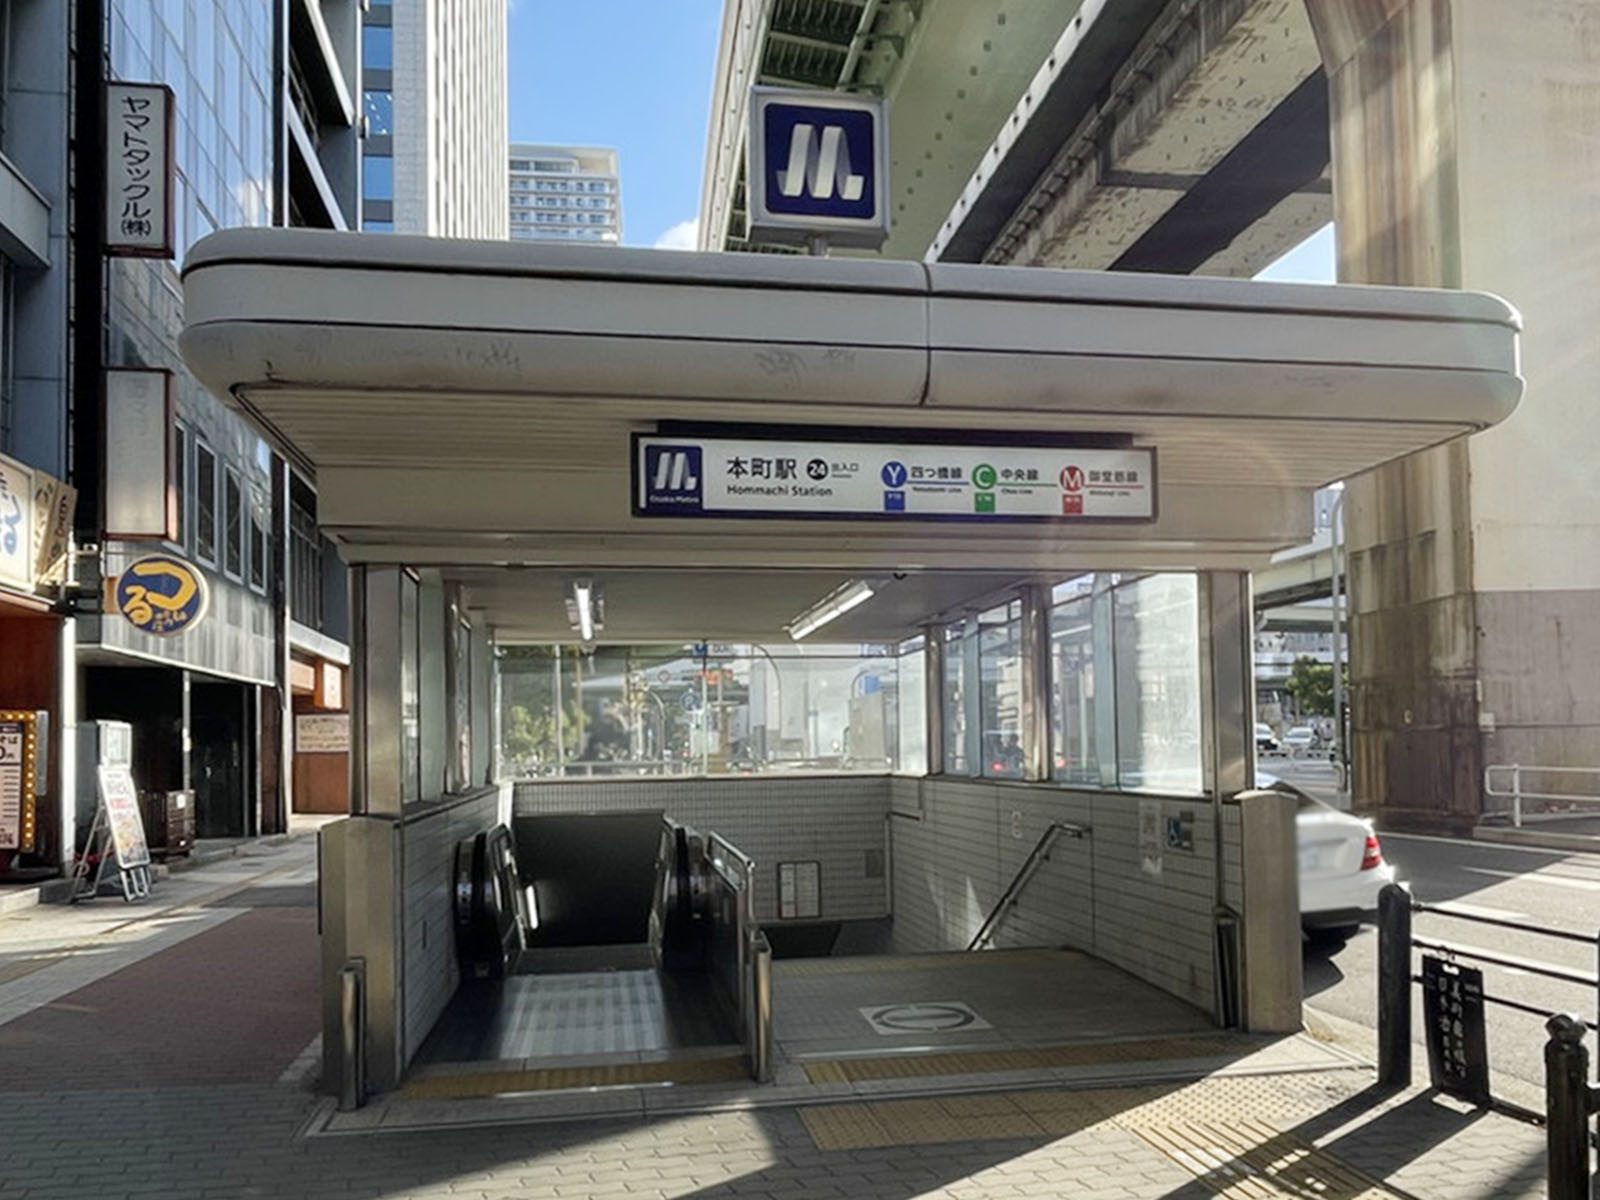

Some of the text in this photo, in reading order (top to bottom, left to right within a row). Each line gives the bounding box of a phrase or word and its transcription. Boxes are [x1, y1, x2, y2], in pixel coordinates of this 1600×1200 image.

[726, 456, 797, 479] 本町駅
[727, 485, 833, 496] Hommachi Station
